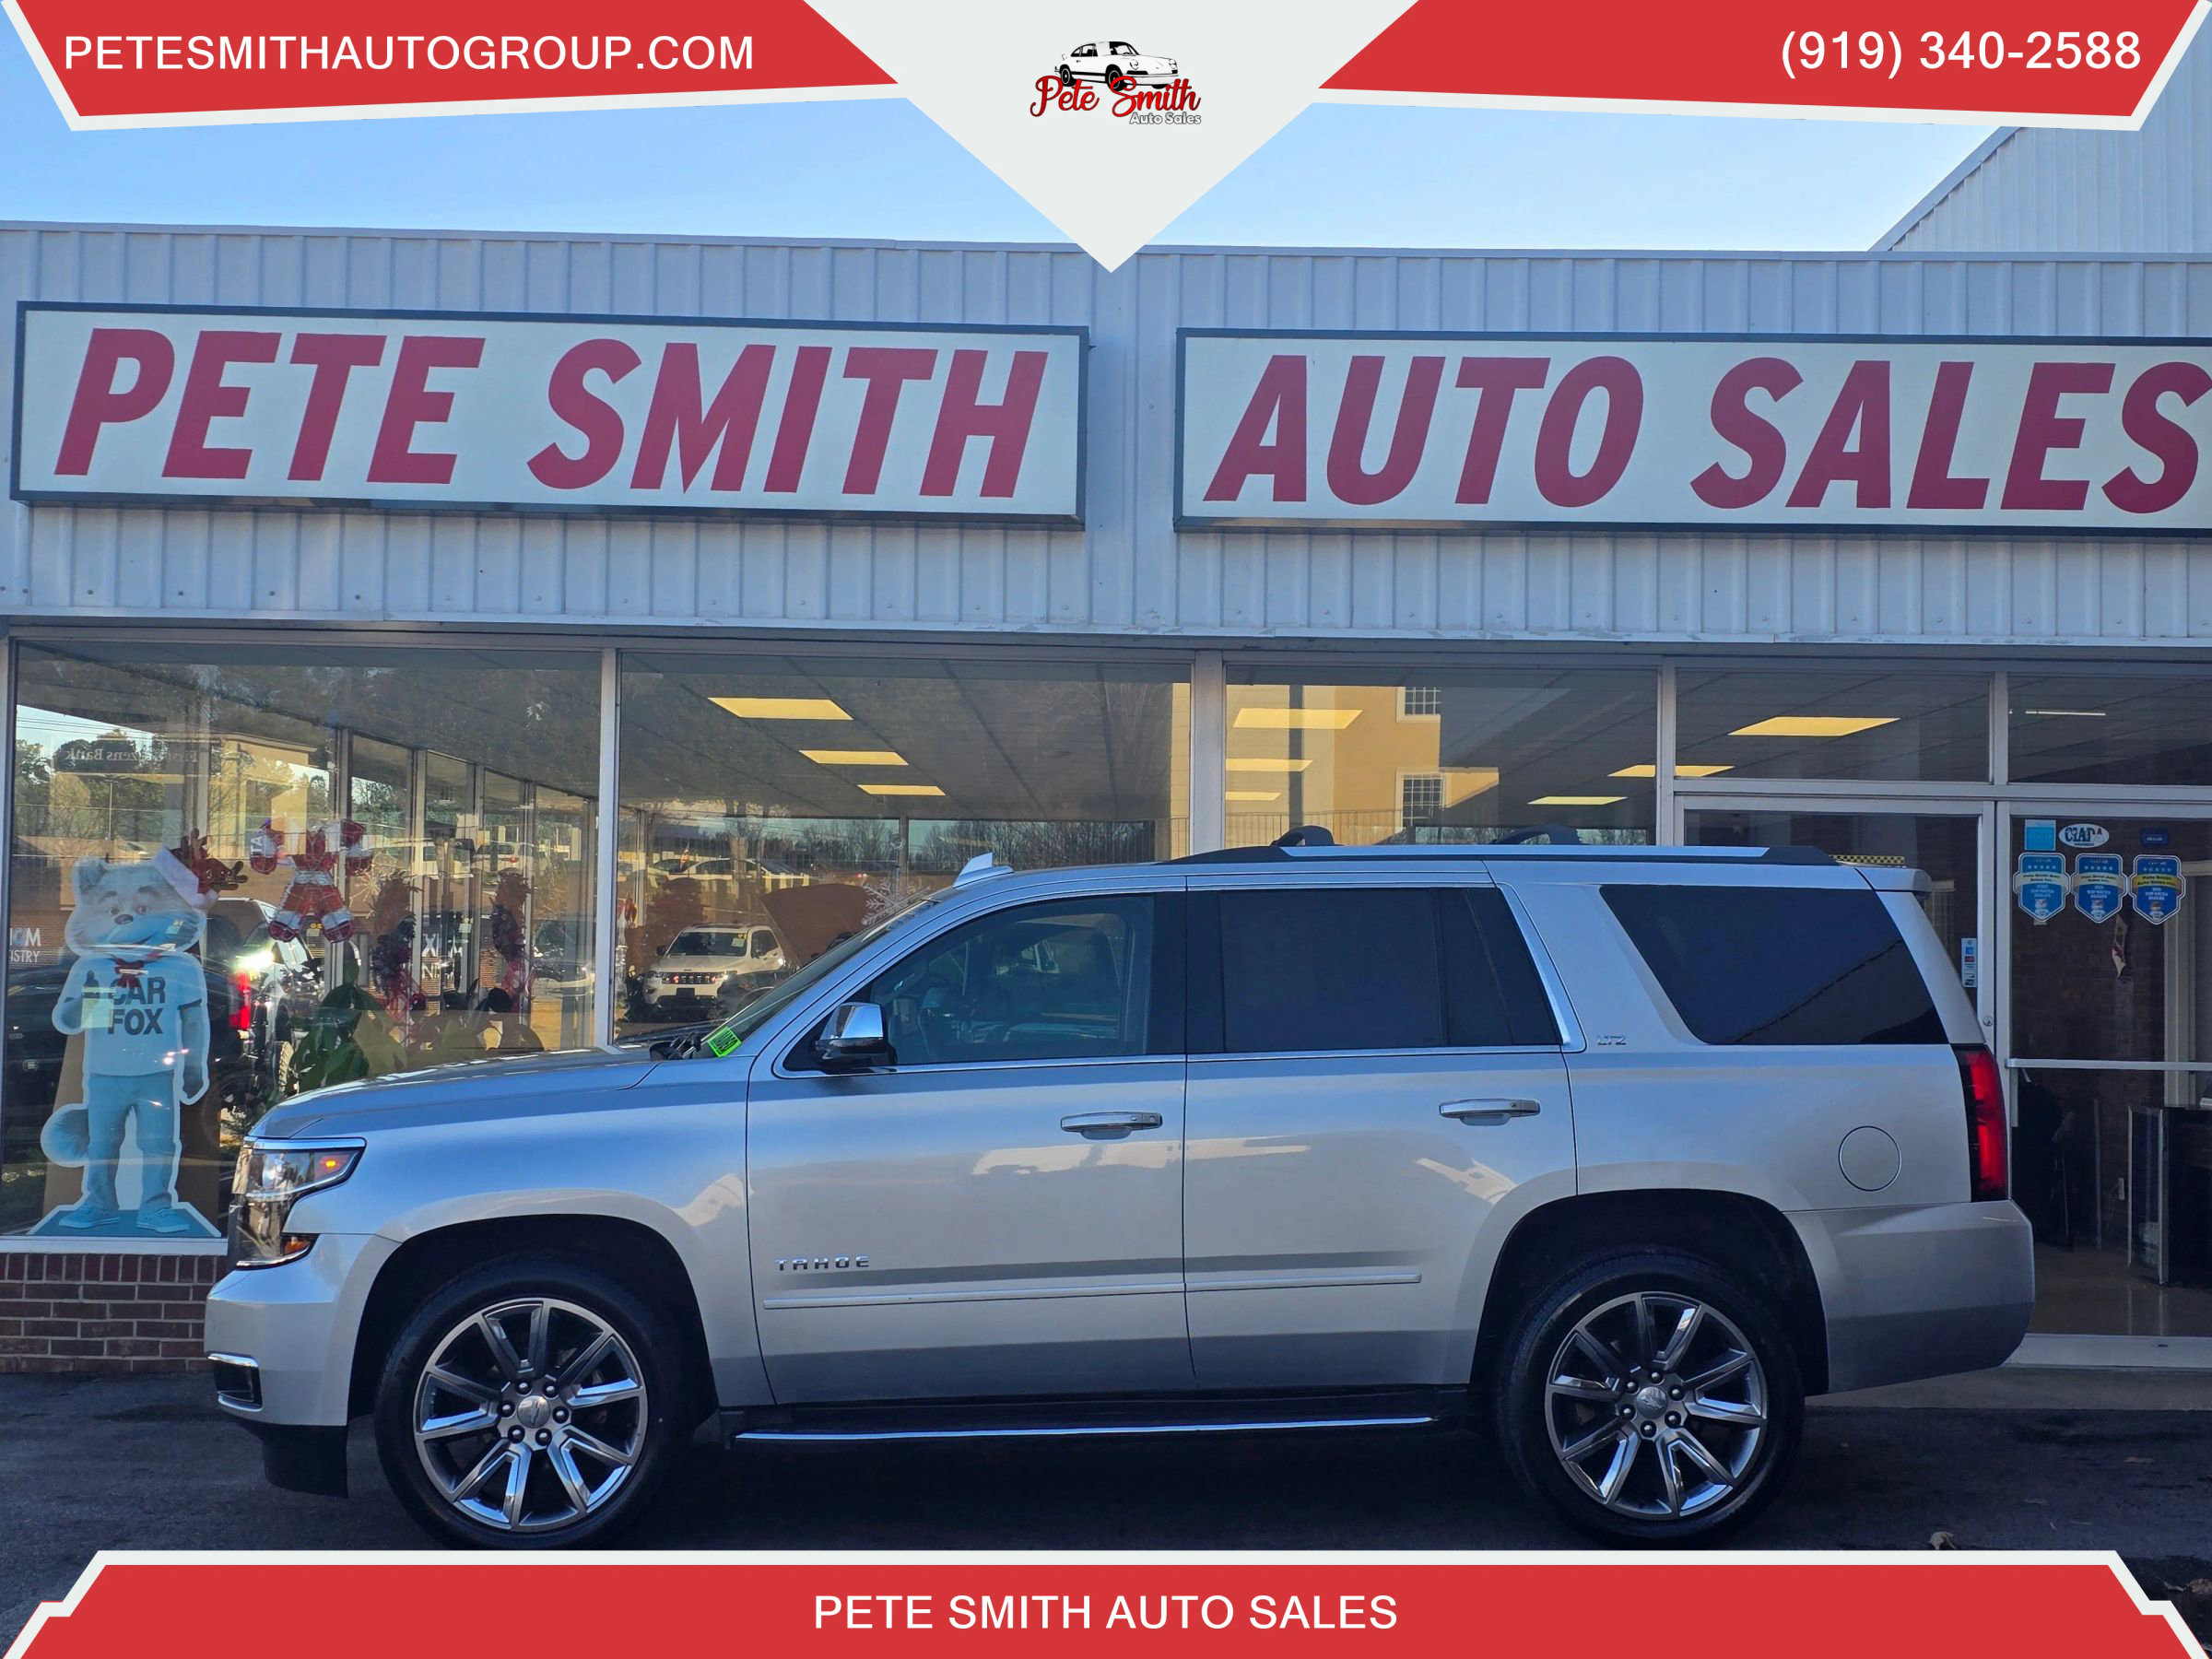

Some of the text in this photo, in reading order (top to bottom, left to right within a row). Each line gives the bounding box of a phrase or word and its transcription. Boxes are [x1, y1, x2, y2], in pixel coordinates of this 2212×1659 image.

[55, 328, 1048, 499] PETE SMITH
[1207, 355, 2212, 515] AUTO SALES
[108, 976, 167, 1006] CAR
[107, 1007, 164, 1035] FOX
[775, 1253, 871, 1271] TAHOE
